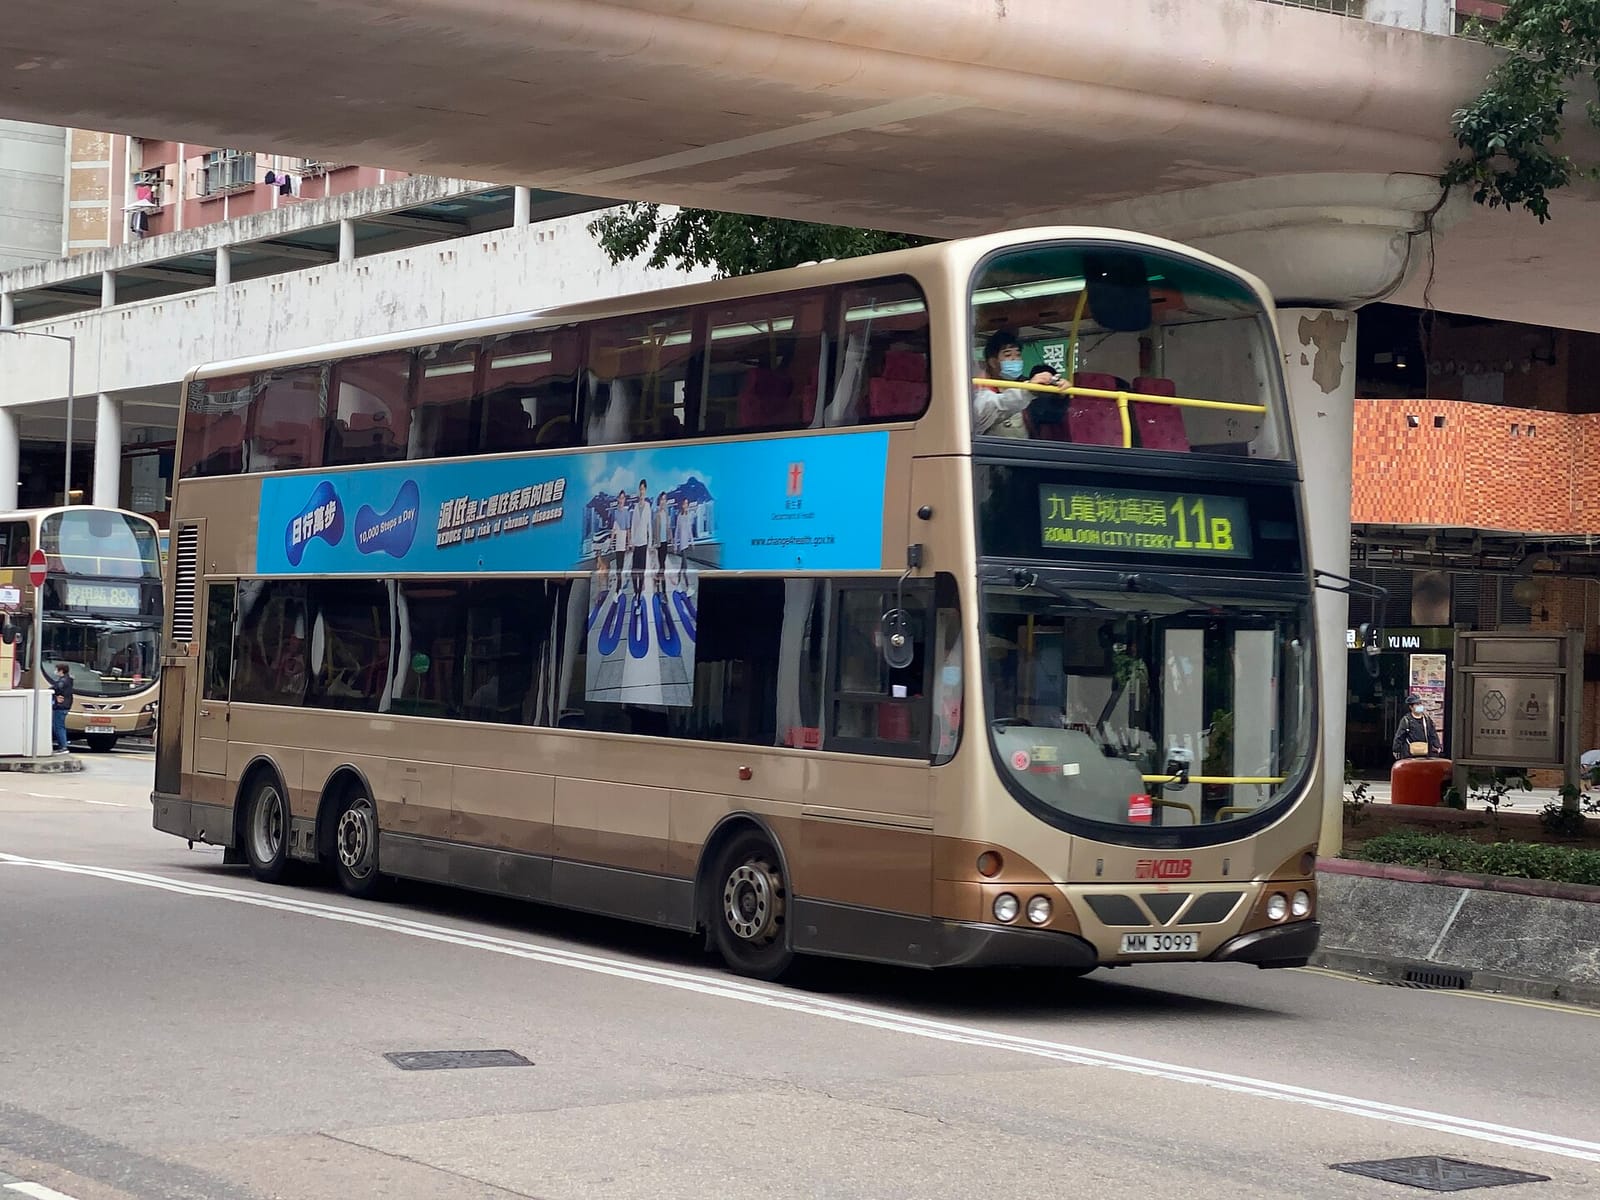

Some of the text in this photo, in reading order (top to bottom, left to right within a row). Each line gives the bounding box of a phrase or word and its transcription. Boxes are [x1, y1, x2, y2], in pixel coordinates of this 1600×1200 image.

[437, 478, 565, 530] 減低患上慢性疾病的機會
[1047, 492, 1235, 551] 九龍城碼頭 11B
[292, 501, 337, 545] 日行萬步
[359, 508, 416, 544] 10,000 Steps a Day
[437, 507, 563, 546] REDUCE the risk of chronic diseases
[1044, 526, 1176, 549] KOWLOON CITY FERRY
[1388, 636, 1400, 648] YU
[1402, 636, 1420, 648] MAI
[1151, 858, 1193, 879] KMB
[1126, 935, 1192, 951] MM 3099
